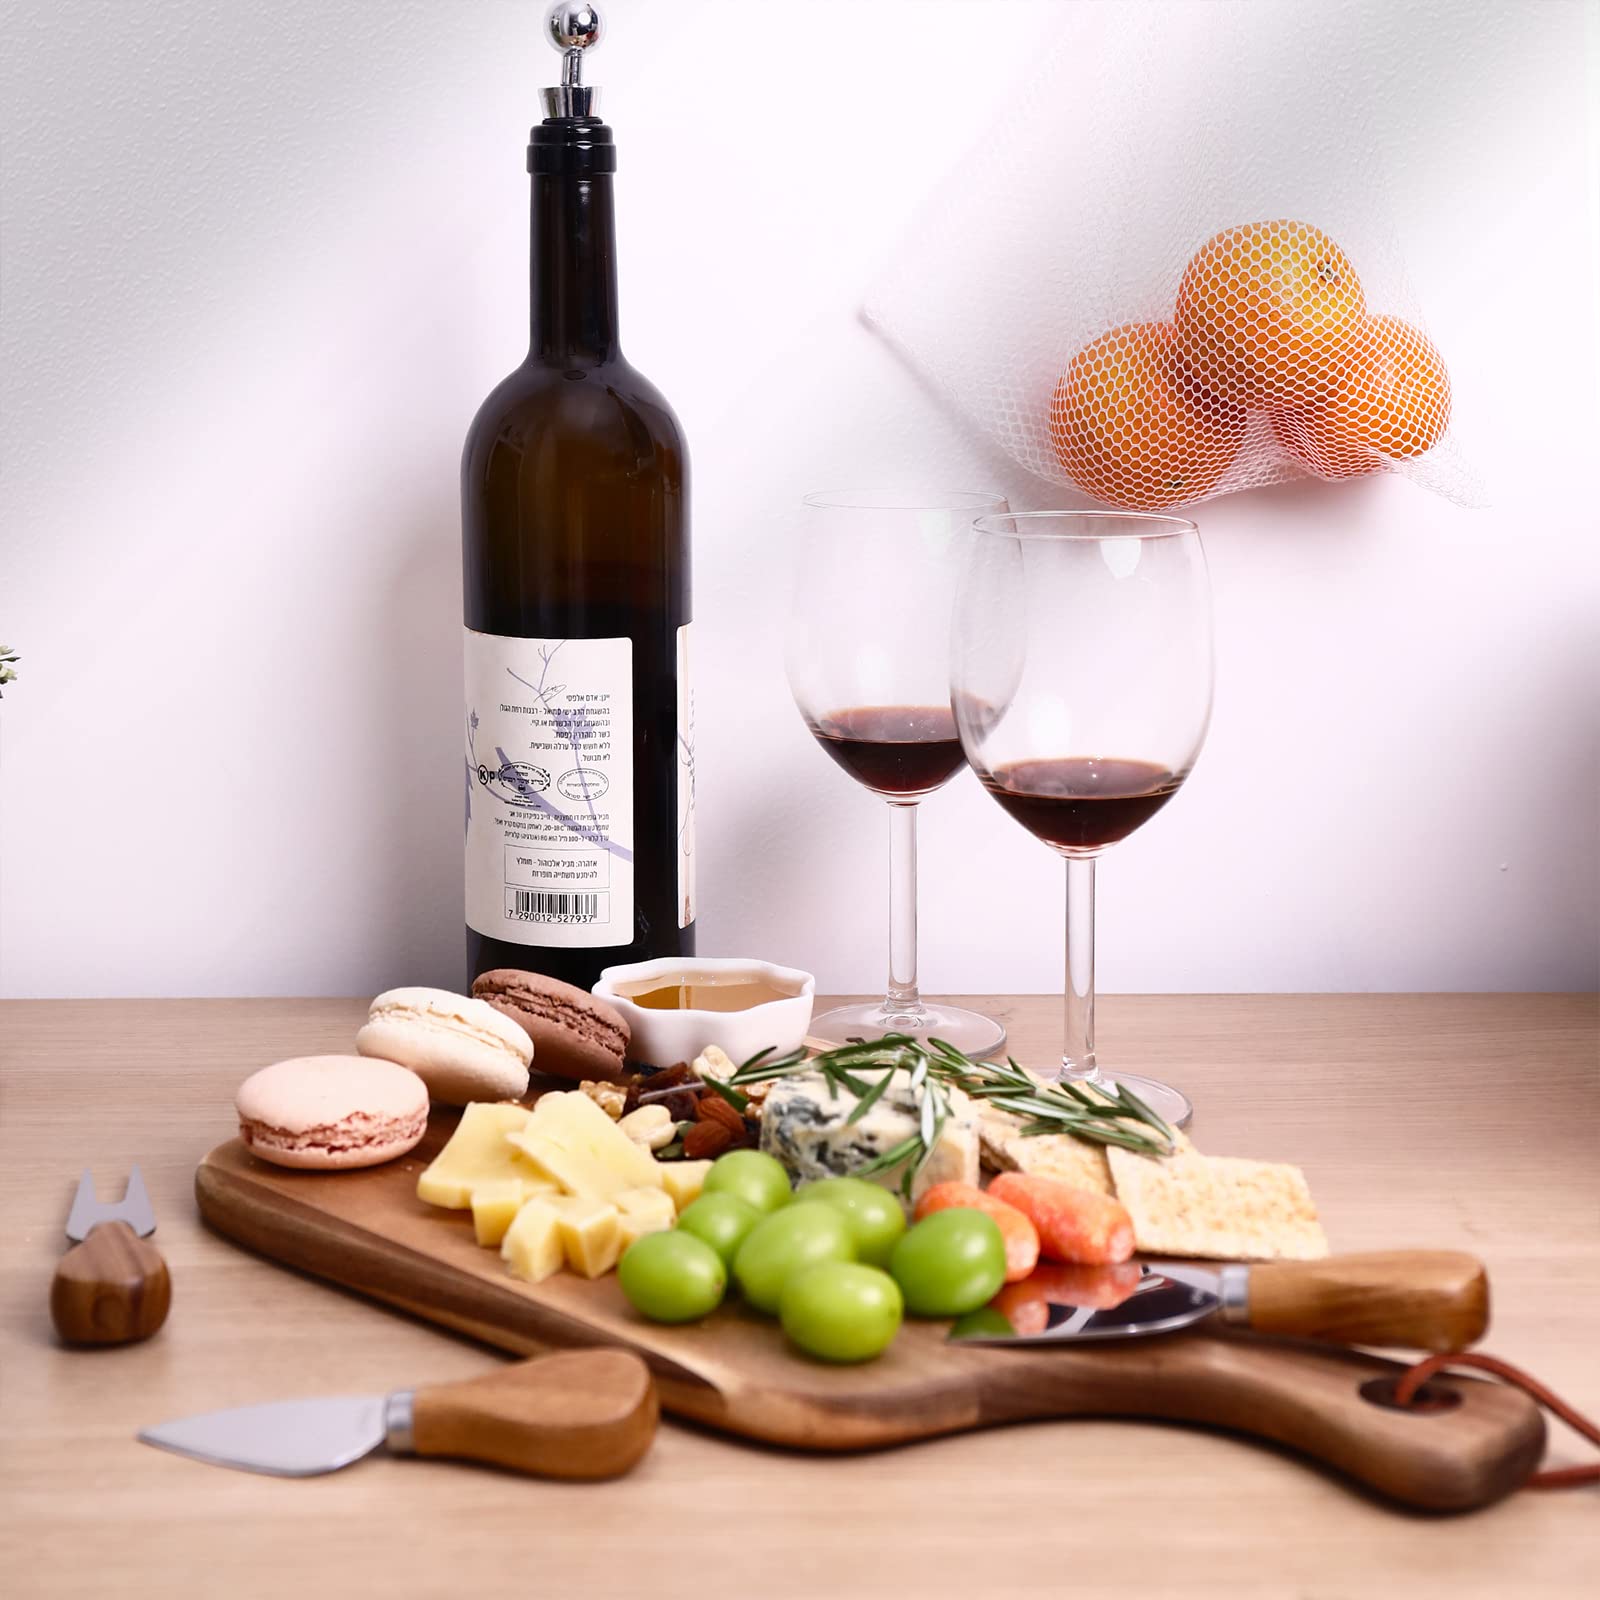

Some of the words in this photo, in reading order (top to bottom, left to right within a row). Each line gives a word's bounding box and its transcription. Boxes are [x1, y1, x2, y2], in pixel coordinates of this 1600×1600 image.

[566, 694, 585, 702] אלפסי
[586, 694, 598, 702] אדם
[523, 706, 538, 714] רבנות
[586, 707, 610, 715] בהשגחת
[573, 731, 596, 739] למהדרין
[553, 742, 569, 750] ערלה
[583, 742, 597, 750] חשש
[516, 857, 533, 866] מומלץ
[537, 858, 560, 867] אלכוהול
[561, 860, 575, 868] מכיל
[575, 860, 598, 868] אזהרה:
[532, 870, 553, 878] מופרזת
[553, 871, 575, 879] משתייה
[576, 871, 598, 879] להימנע
[508, 909, 514, 918] 7
[518, 911, 552, 922] 290012
[557, 914, 594, 923] 527937
